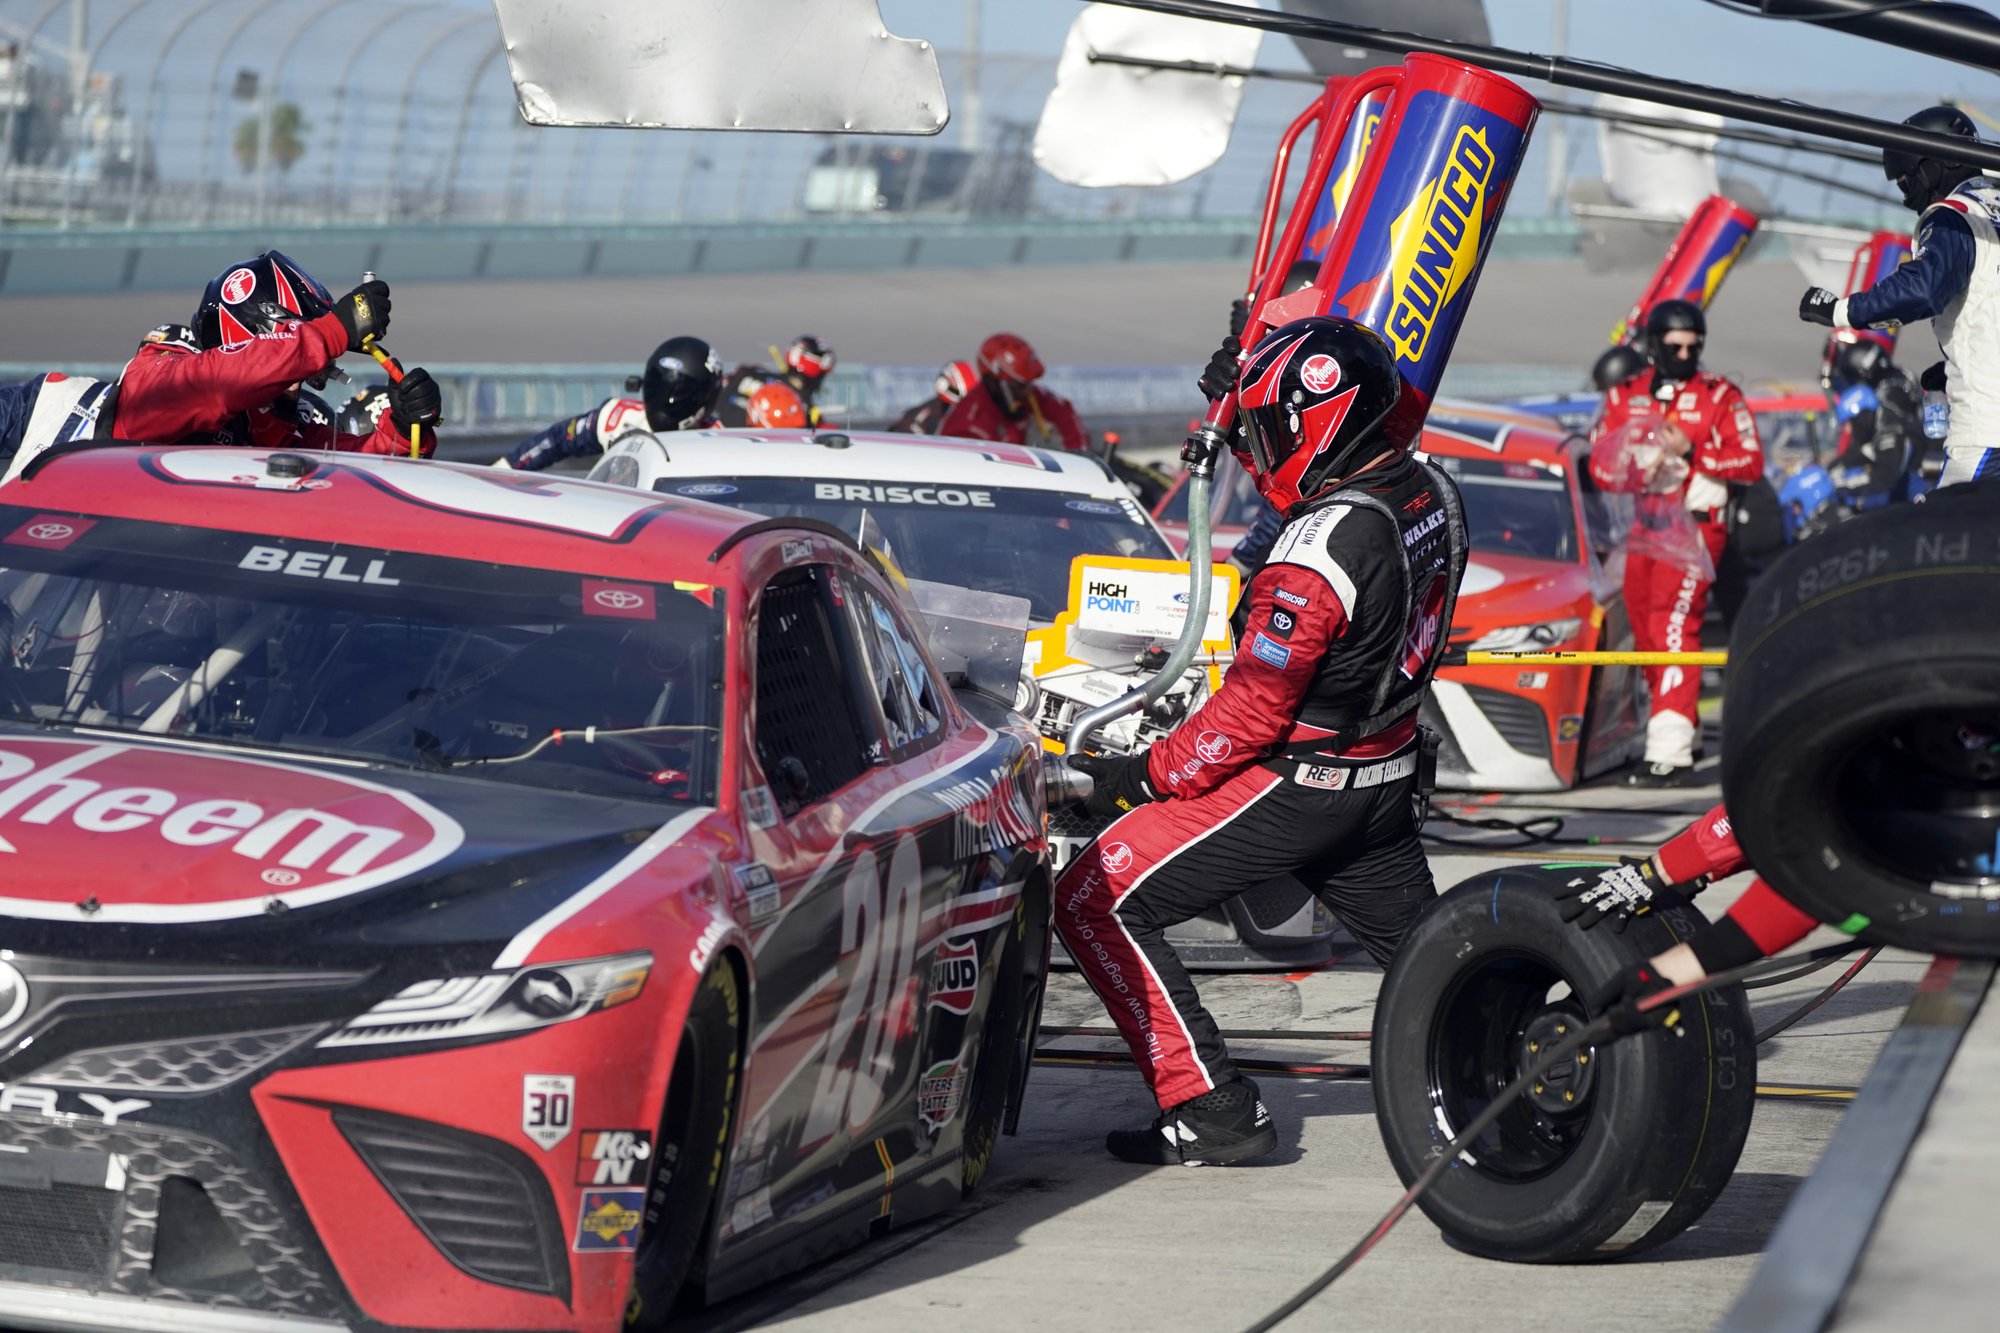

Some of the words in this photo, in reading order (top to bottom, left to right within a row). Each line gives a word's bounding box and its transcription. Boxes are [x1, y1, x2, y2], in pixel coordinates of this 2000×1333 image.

[1391, 132, 1491, 355] SUNOCO
[1304, 361, 1340, 390] Rheem
[72, 404, 96, 423] Stewa
[815, 483, 995, 508] BRISCOE
[238, 544, 400, 587] BELL
[1914, 534, 1971, 566] PN
[1797, 544, 1889, 600] 4928
[1087, 596, 1134, 615] POINT
[1089, 581, 1127, 599] HIGH
[1277, 590, 1308, 607] NASCAR
[1200, 735, 1231, 763] Rheem
[1353, 763, 1386, 788] RACING
[0, 744, 404, 876] heem
[1102, 846, 1133, 874] Rheem
[1091, 942, 1129, 995] degree
[1124, 996, 1151, 1031] new
[1146, 1032, 1165, 1066] The
[1717, 1028, 1737, 1090] C13
[529, 1093, 569, 1127] 30
